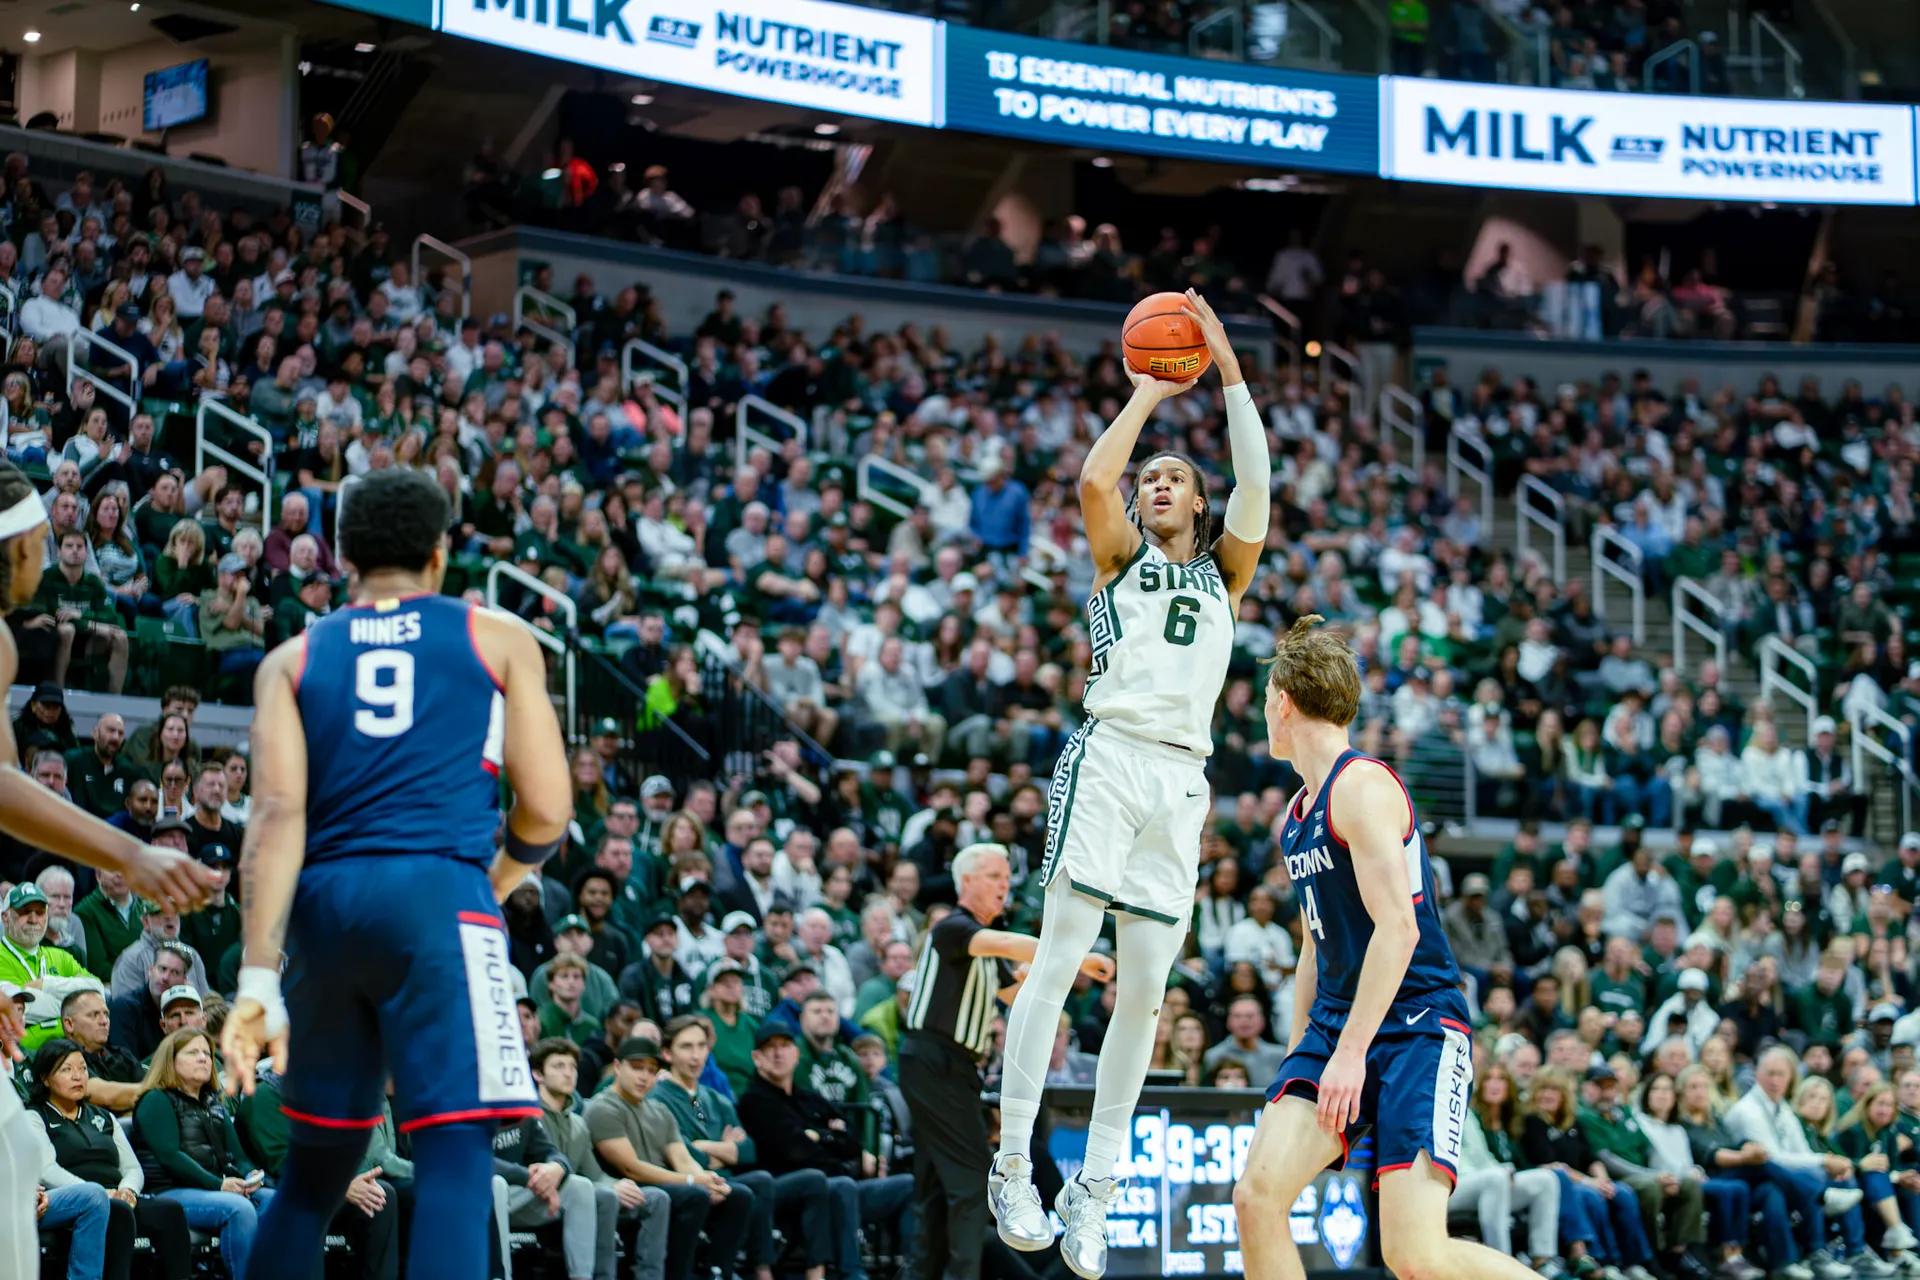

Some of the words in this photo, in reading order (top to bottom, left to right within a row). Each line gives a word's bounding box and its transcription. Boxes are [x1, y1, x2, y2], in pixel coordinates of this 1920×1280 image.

[474, 0, 635, 44] LK
[717, 11, 902, 70] NUTRIENT
[717, 48, 902, 98] POWERHOUSE
[985, 51, 1018, 80] 13
[1020, 56, 1173, 101] ESSENTIAL
[1175, 76, 1337, 118] NUTRIENTS
[994, 88, 1039, 119] TO
[1040, 94, 1151, 133] POWER
[1153, 110, 1249, 144] EVERY
[1251, 120, 1329, 152] PLAY
[1425, 106, 1597, 165] MILK
[1682, 124, 1880, 156] NUTRIENT
[1682, 158, 1882, 183] POWERHOUSE
[1150, 357, 1199, 374] ELITE
[1140, 562, 1222, 603] STATE
[350, 611, 421, 645] HINES
[1163, 595, 1201, 647] 6
[354, 649, 415, 738] 9
[1305, 885, 1325, 940] 4
[482, 936, 524, 1088] HUSKIES
[1187, 1204, 1238, 1244] 1ST
